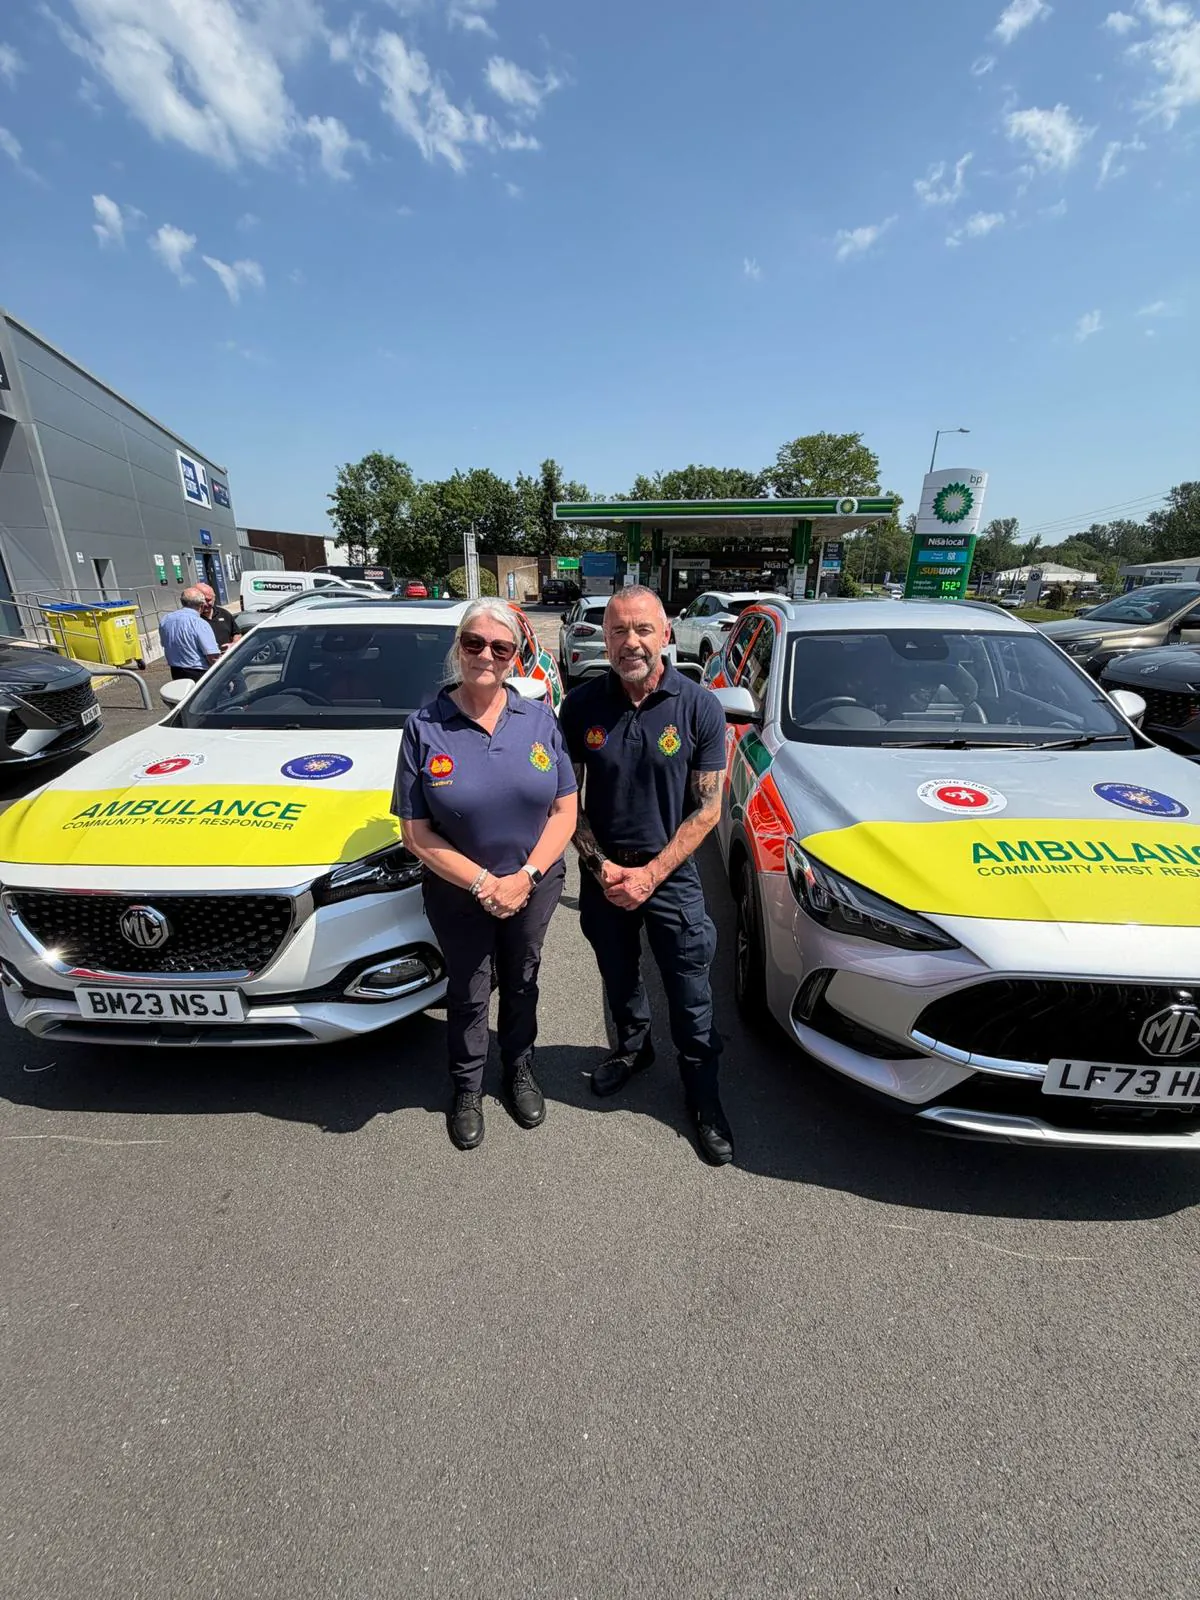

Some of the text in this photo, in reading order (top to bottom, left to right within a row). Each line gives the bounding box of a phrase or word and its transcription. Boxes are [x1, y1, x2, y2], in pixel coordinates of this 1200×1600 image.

[970, 474, 983, 486] bp
[946, 537, 965, 546] local
[920, 566, 961, 576] SUBWAY
[253, 580, 303, 591] enterprise
[72, 799, 308, 821] AMBULANCE
[62, 817, 295, 831] COMMUNITY FIRST RESPONDER
[976, 864, 1093, 877] COMMUNITY
[1099, 865, 1152, 876] FIRST
[122, 908, 165, 947] MG
[87, 991, 228, 1017] BM23 NSJ
[1144, 1010, 1200, 1055] MG
[1058, 1063, 1162, 1096] LF73
